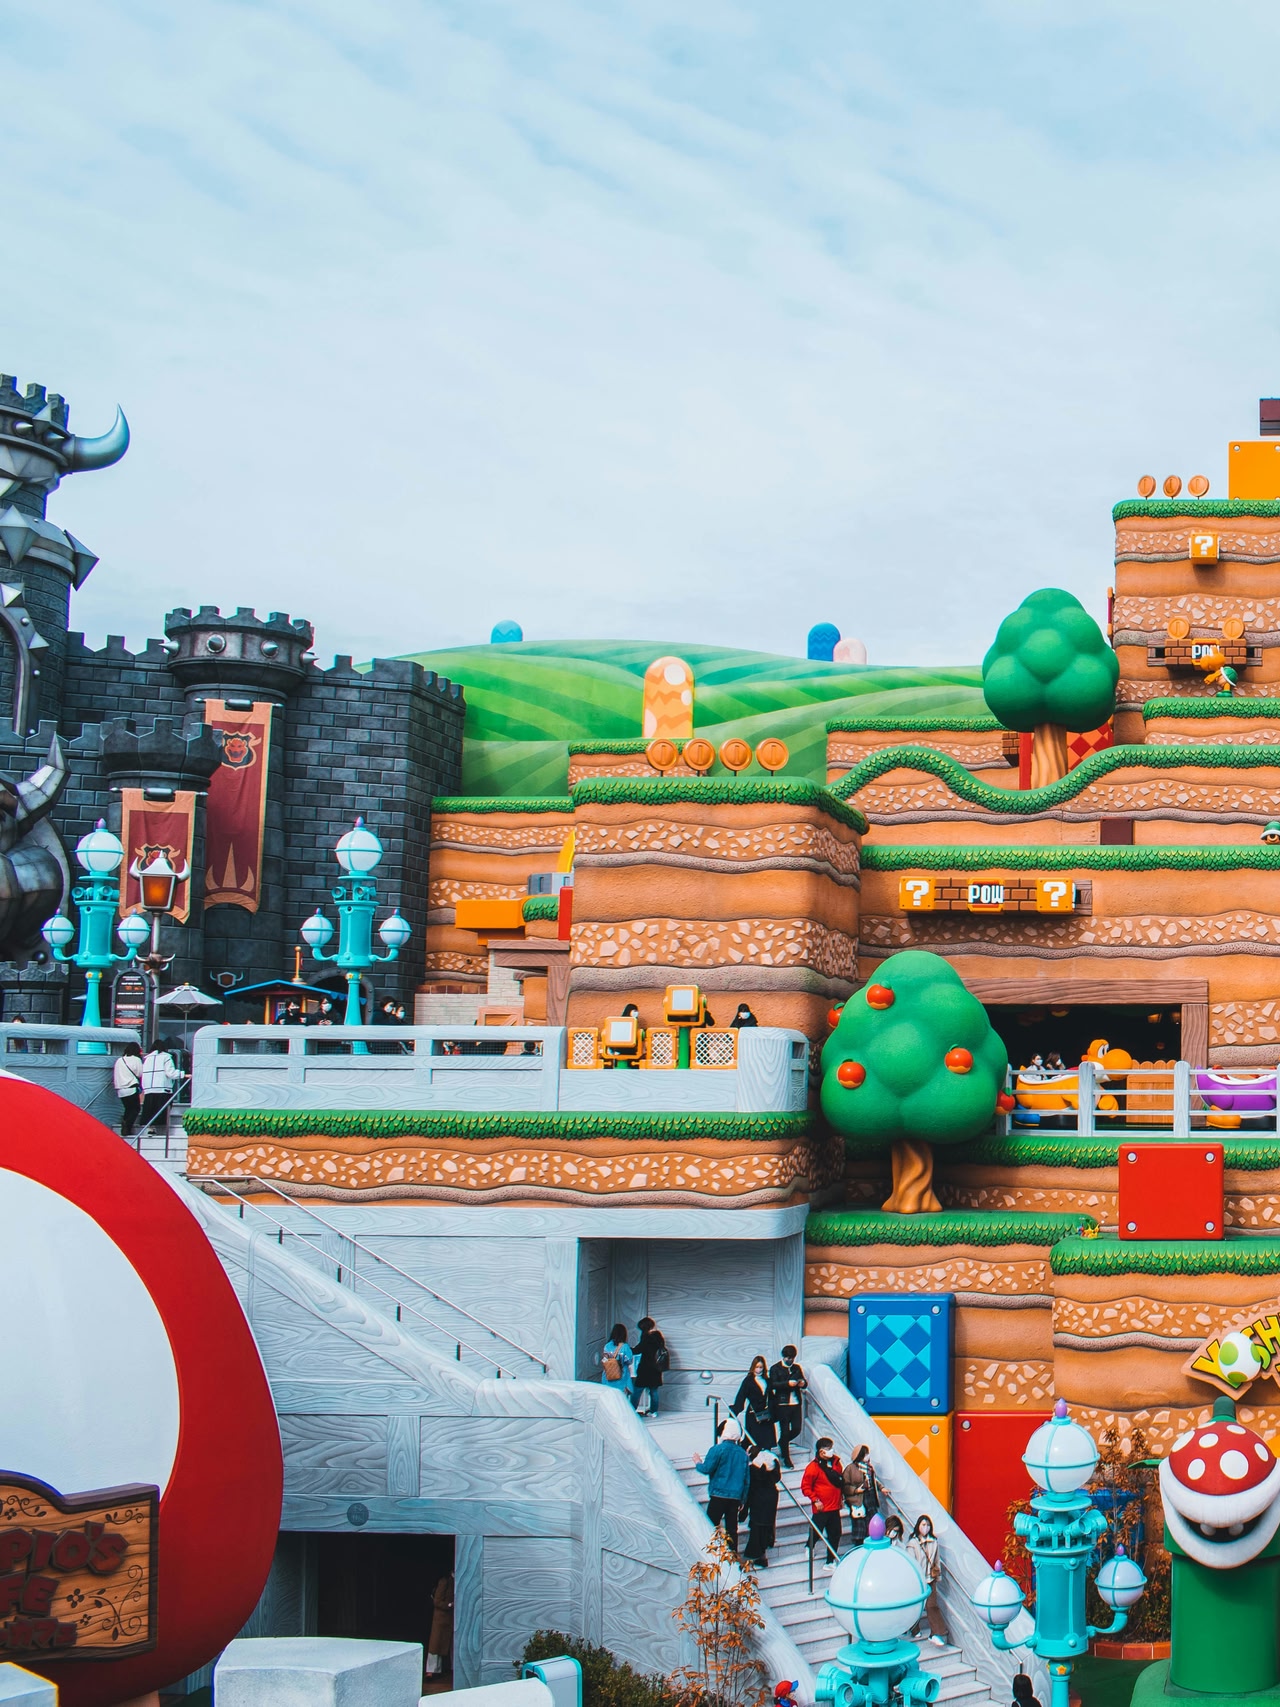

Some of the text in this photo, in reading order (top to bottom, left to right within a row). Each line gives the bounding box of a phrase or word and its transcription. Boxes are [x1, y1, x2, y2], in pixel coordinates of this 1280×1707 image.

[1194, 536, 1214, 555] ?
[905, 880, 1067, 907] ? POW ?
